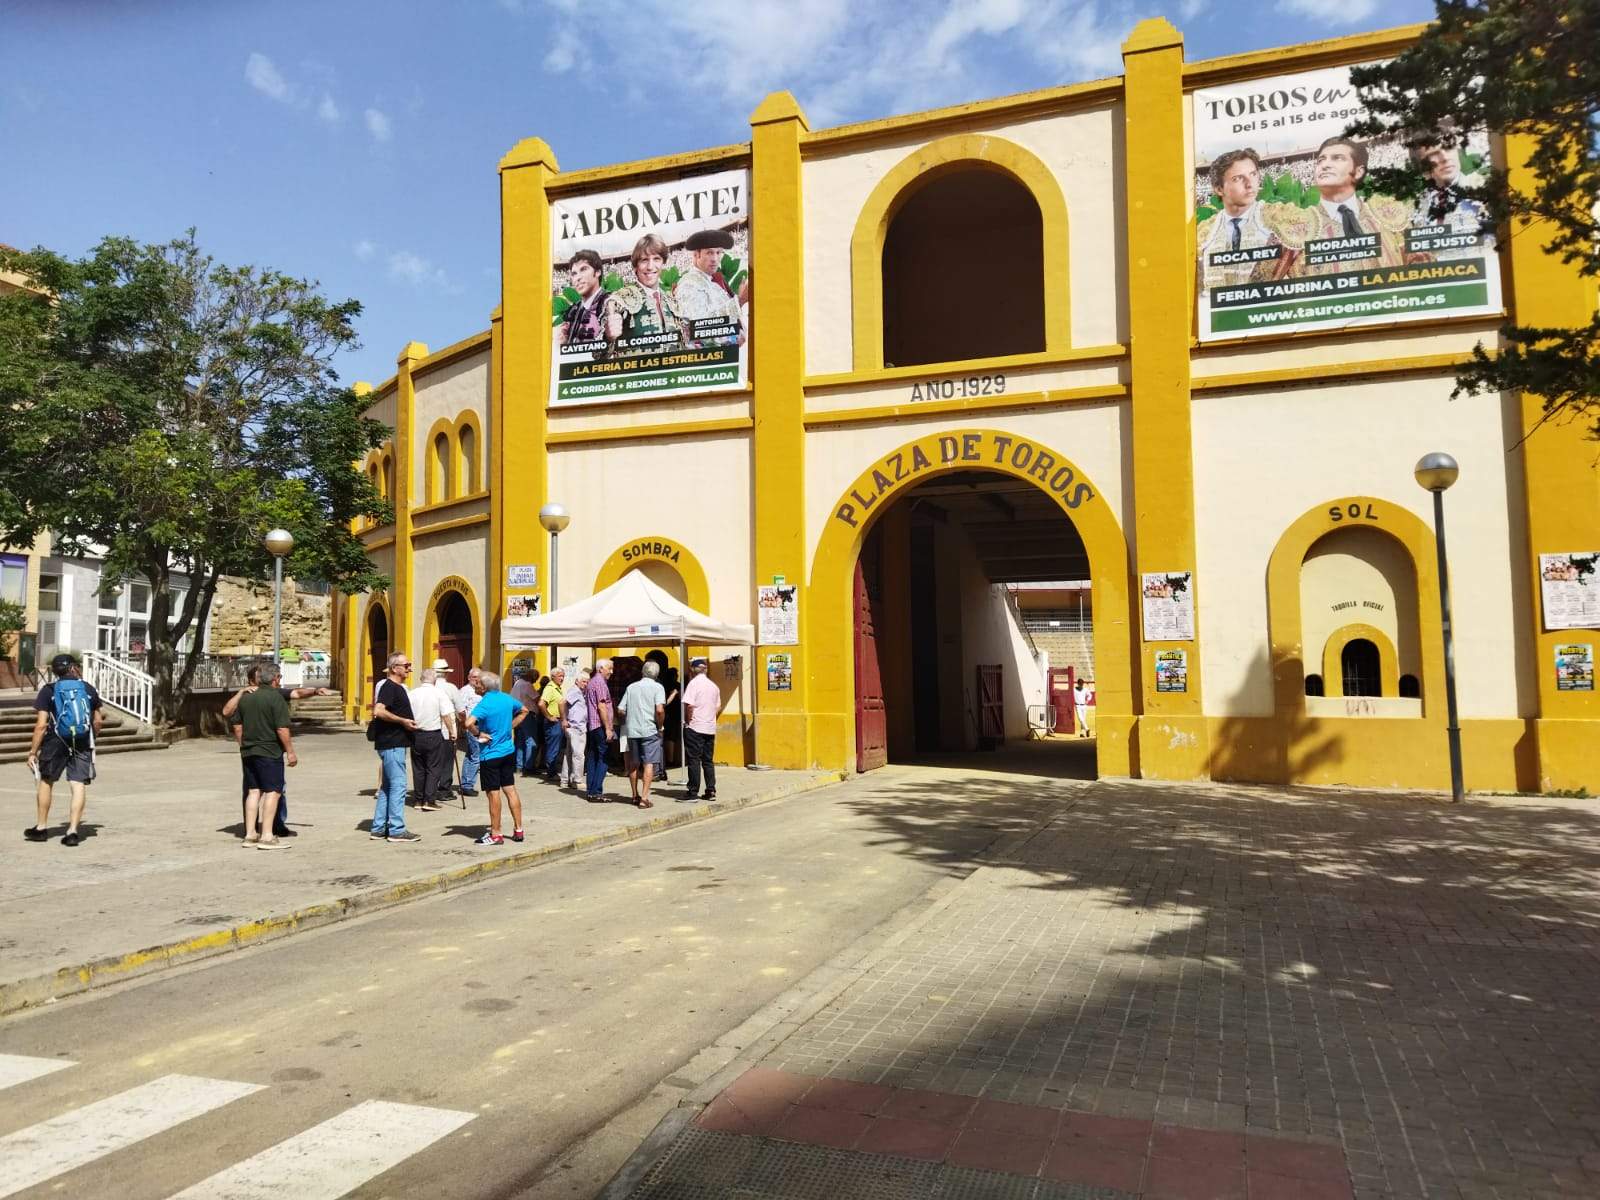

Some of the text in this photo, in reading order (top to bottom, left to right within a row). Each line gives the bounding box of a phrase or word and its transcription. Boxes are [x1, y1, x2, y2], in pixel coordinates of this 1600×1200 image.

[1205, 86, 1308, 120] TOROS
[1312, 87, 1350, 104] en
[1232, 105, 1367, 134] Del 5 al 15 de agos
[560, 185, 740, 240] ¡ABÓNATE!
[1410, 226, 1445, 237] EMILIO
[1309, 235, 1376, 252] MORANTE
[1410, 235, 1477, 251] DE JUSTO
[1213, 247, 1279, 264] ROCA REY
[1310, 250, 1376, 264] DE LA PUEBLA
[1216, 264, 1478, 303] FERIA TAURINA DE LA ALBAHACA
[1248, 293, 1446, 324] www.tauroemocion.es
[694, 317, 725, 328] ANTONIO
[617, 333, 679, 348] EL CORDOBÉS
[694, 326, 736, 339] FERRERA
[561, 341, 607, 353] CAYETANO
[573, 350, 724, 377] ¡LA FERIA DE LAS ESTRELLAS!
[561, 387, 569, 396] 4
[570, 382, 617, 395] CORRIDAS
[626, 379, 668, 390] REJONES
[677, 372, 734, 385] NOVILLADA
[835, 433, 1096, 529] PLAZA DE TOROS
[1328, 503, 1378, 521] SOL
[622, 542, 680, 563] SOMBRA
[1331, 600, 1385, 613] TAQUILLA OFICIAL
